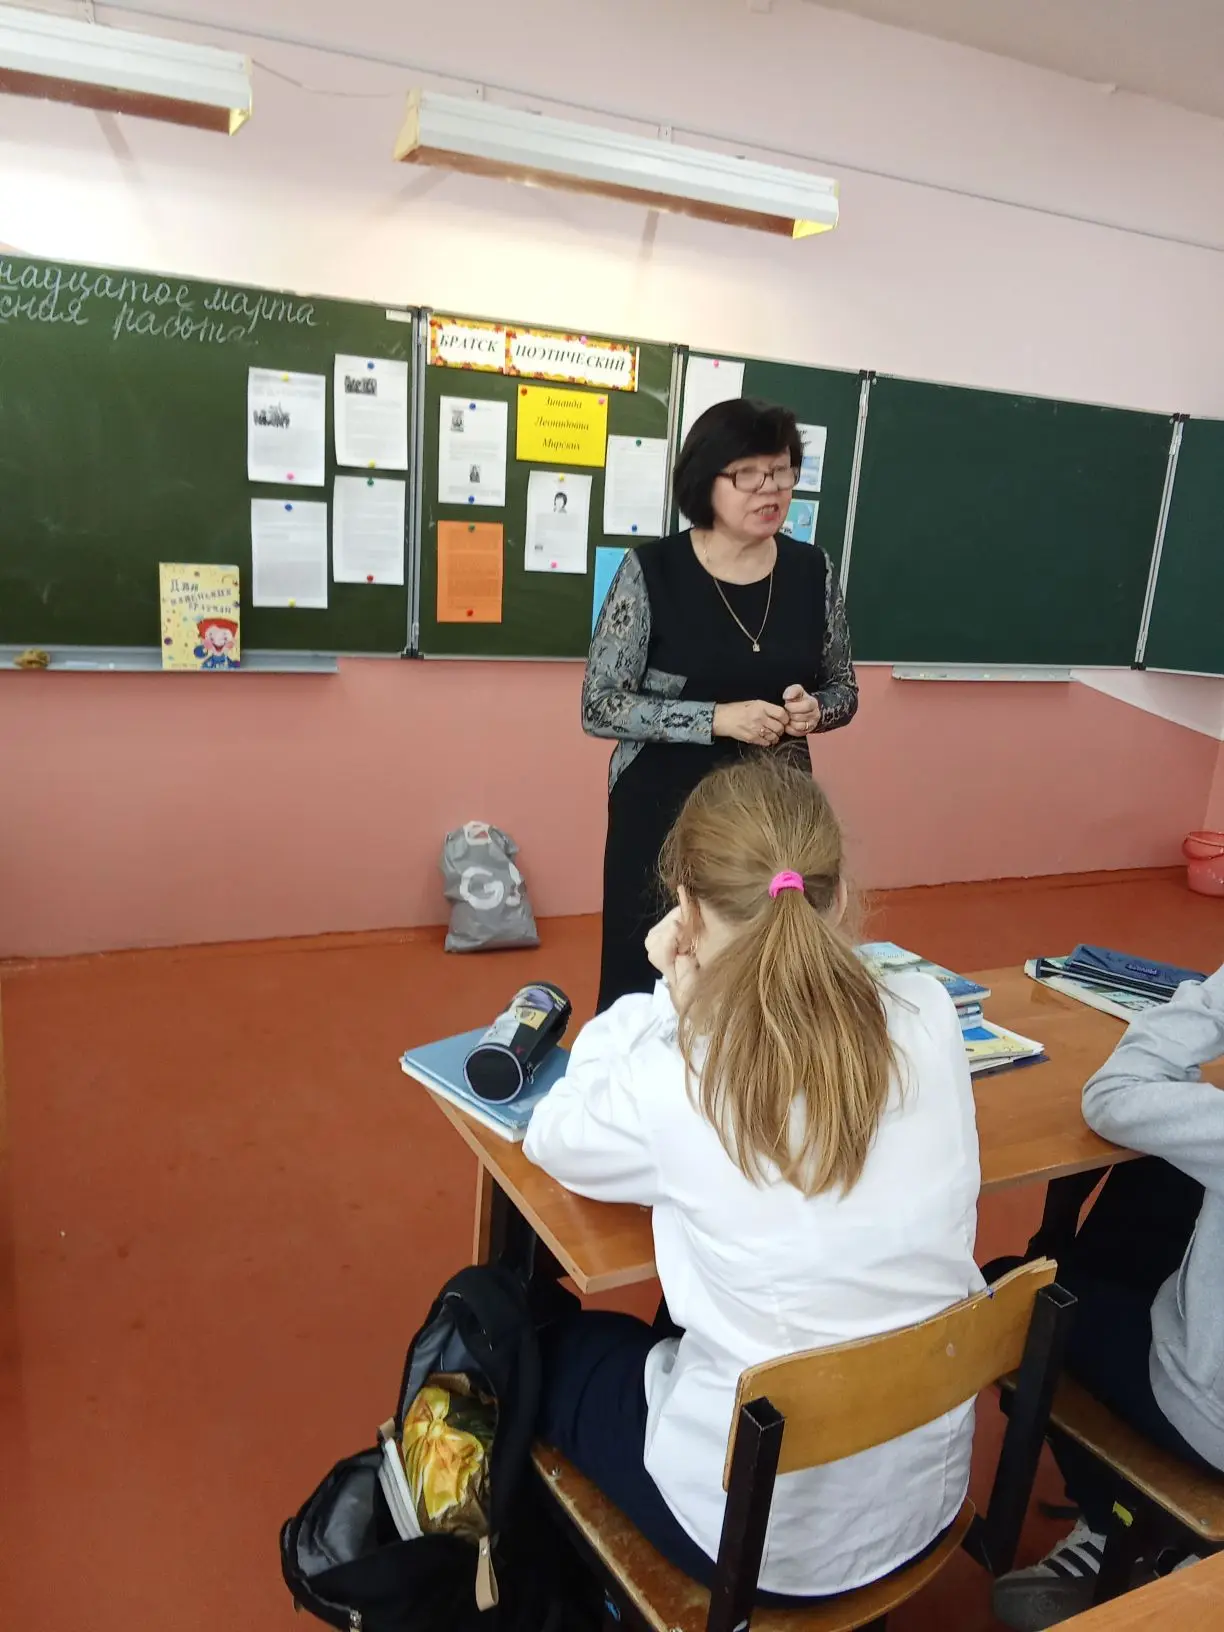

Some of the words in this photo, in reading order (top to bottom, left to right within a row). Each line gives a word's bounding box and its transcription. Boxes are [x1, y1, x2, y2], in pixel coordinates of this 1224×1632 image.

[204, 287, 318, 333] марта
[440, 334, 499, 352] БРАТСК
[515, 344, 626, 371] ПОЭТИЧЕСКИЙ
[534, 416, 590, 431] Леонидовна
